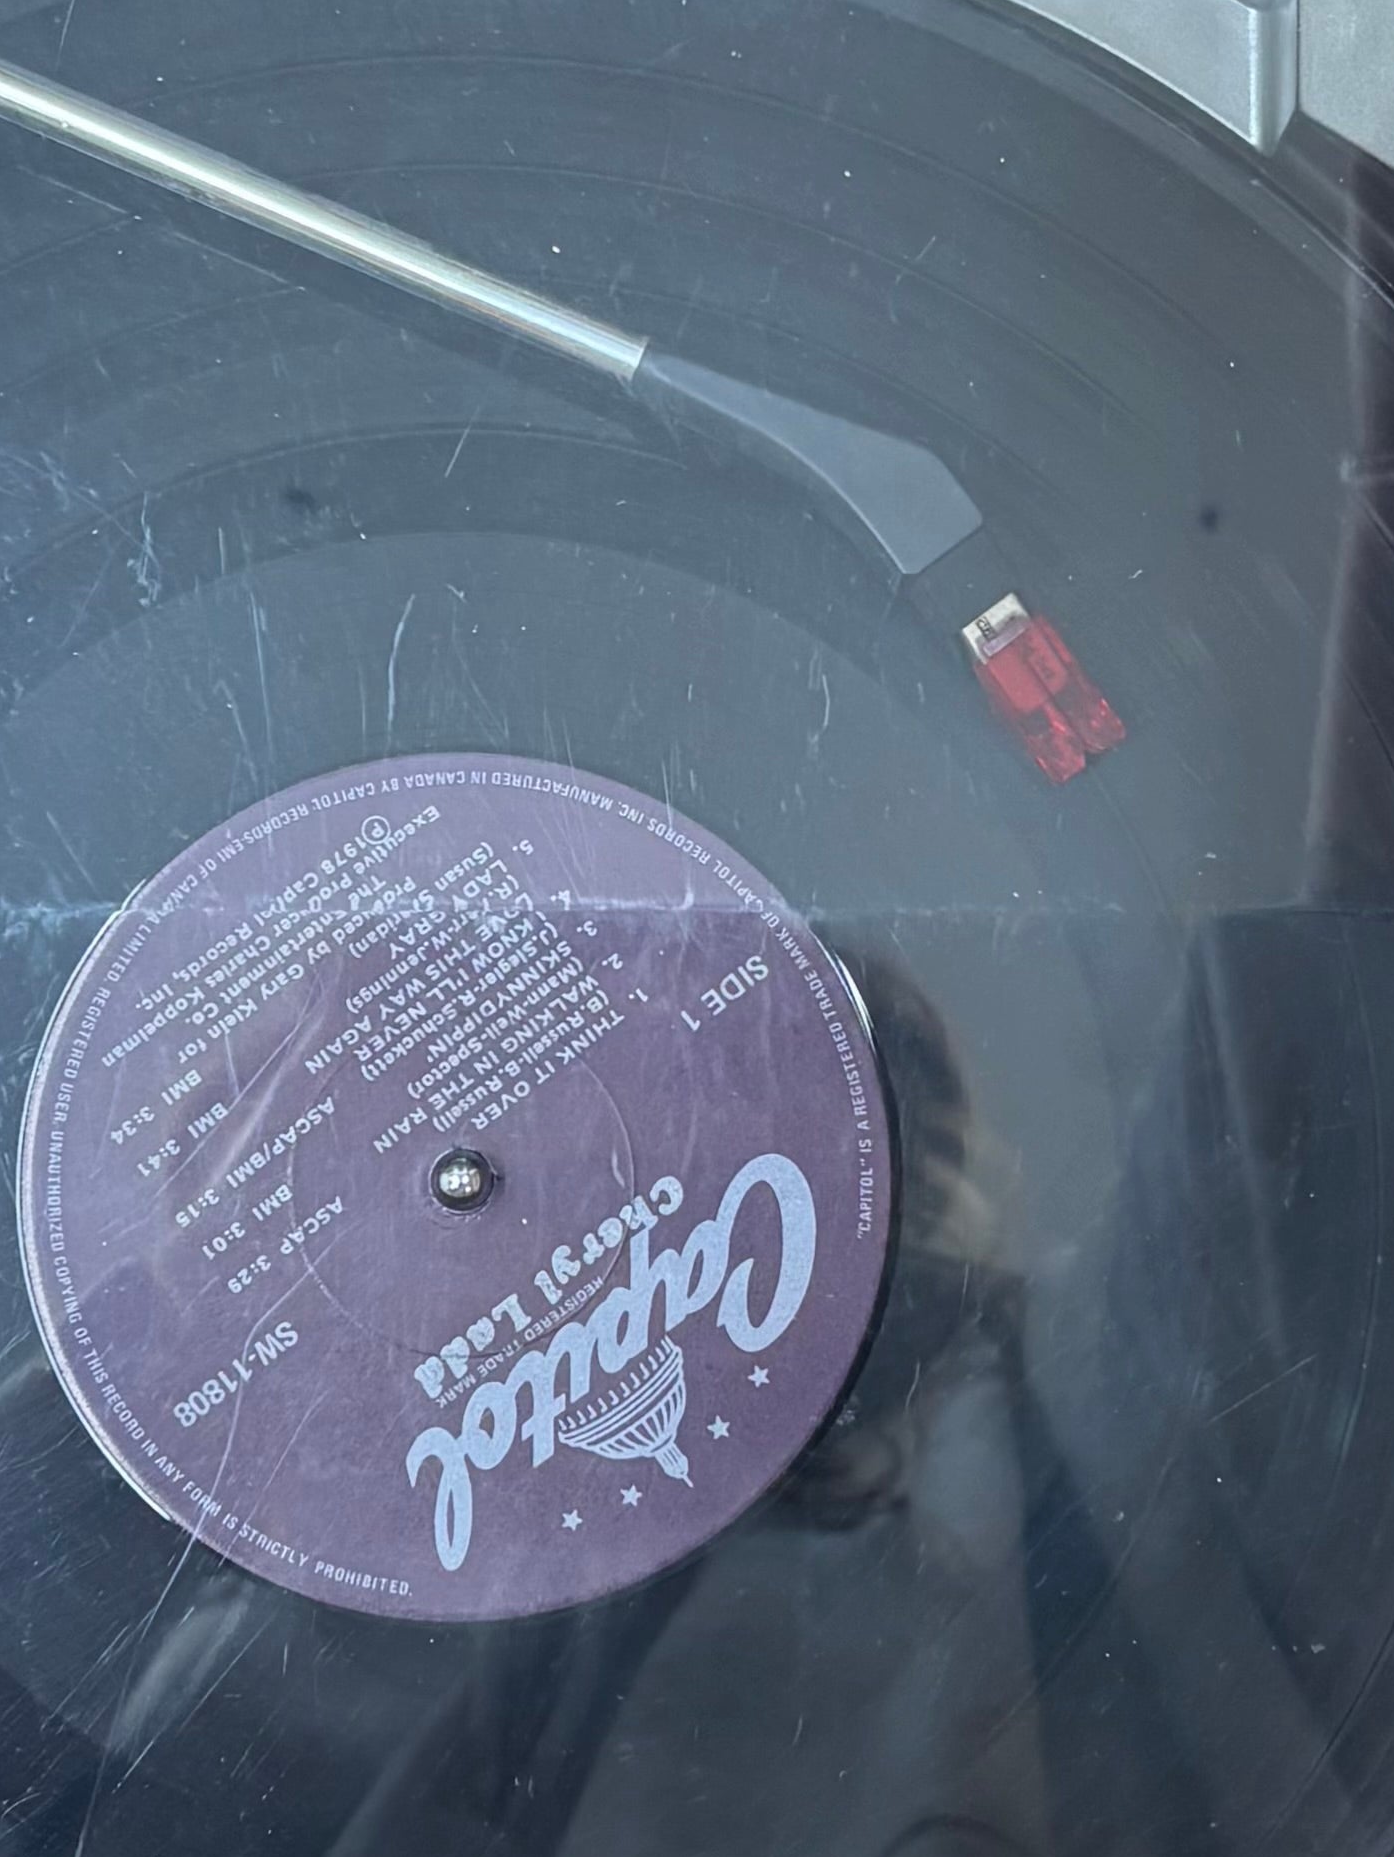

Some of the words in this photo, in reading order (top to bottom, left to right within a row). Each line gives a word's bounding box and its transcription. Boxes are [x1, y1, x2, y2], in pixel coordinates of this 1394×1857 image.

[310, 781, 375, 810] CAPITOL
[380, 776, 399, 793] BY
[402, 770, 466, 788] CANADA
[469, 769, 487, 785] IN
[490, 771, 613, 811] MANUFACTURED
[617, 800, 645, 824] INC.
[215, 803, 309, 862] RECORDS-EMI
[352, 804, 440, 874] Executive
[511, 838, 534, 855] 5.
[646, 817, 711, 864] RECORDS
[197, 857, 217, 879] OF
[433, 841, 494, 891] (Susan
[451, 858, 508, 912] LADY
[347, 874, 387, 911] The
[549, 888, 572, 911] 4.
[388, 907, 446, 960] GRAY
[474, 891, 534, 945] LOVE
[534, 910, 547, 921] I
[575, 919, 598, 937] 3.
[759, 910, 780, 928] OF
[103, 923, 152, 982] LIMITED.
[171, 921, 253, 982] Records,
[203, 934, 271, 988] Charles
[306, 939, 332, 965] by
[424, 938, 476, 981] THIS
[471, 917, 534, 973] KNOW
[600, 952, 623, 970] 2.
[774, 925, 810, 970] MARK
[134, 982, 174, 1010] Inc.
[259, 962, 304, 1001] Gary
[378, 977, 426, 1021] WAY
[424, 967, 470, 1001] I'LL
[426, 940, 571, 1062] SKINNYDIPPIN'
[627, 987, 649, 1002] 1.
[700, 954, 769, 1015] SIDE
[803, 969, 837, 1020] TRADE
[63, 986, 111, 1079] REGISTERED
[101, 985, 205, 1067] Koppelman
[184, 1001, 219, 1025] Co.
[206, 997, 258, 1039] Klein
[352, 1000, 427, 1061] NEVER
[499, 974, 599, 1053] WALKING
[679, 1009, 701, 1031] 1
[177, 1037, 207, 1064] for
[304, 1014, 372, 1074] AGAIN
[554, 1009, 625, 1065] THINK
[472, 1049, 500, 1075] IN
[533, 1059, 556, 1085] IT
[828, 1021, 867, 1116] REGISTERED
[51, 1081, 74, 1125] USER.
[160, 1068, 202, 1105] BMI
[427, 1072, 475, 1111] THE
[469, 1080, 530, 1130] OVER
[109, 1105, 155, 1145] 3:34
[186, 1101, 229, 1139] BMI
[372, 1106, 428, 1153] RAIN
[855, 1119, 870, 1130] A
[136, 1138, 180, 1177] 3:41
[225, 1096, 334, 1188] ASCAP/BMI
[857, 1137, 872, 1153] IS
[46, 1130, 65, 1252] UNAUTHORIZED
[174, 1187, 220, 1228] 3:15
[251, 1183, 293, 1221] BMI
[856, 1157, 874, 1239] "CAPITOL"
[201, 1221, 246, 1260] 3:01
[279, 1195, 343, 1255] ASCAP
[533, 1175, 683, 1304] Cheryl
[53, 1255, 82, 1324] COPYING
[226, 1254, 272, 1293] 3:29
[523, 1275, 604, 1341] REGISTERED
[72, 1326, 92, 1346] OF
[413, 1293, 531, 1398] Ladd
[82, 1347, 109, 1384] THIS
[173, 1321, 298, 1427] SW-11808
[405, 1154, 823, 1570] Capitol
[476, 1338, 521, 1378] TRADE
[434, 1373, 477, 1409] MARK
[100, 1383, 145, 1440] RECORD
[139, 1438, 159, 1457] IN
[153, 1455, 185, 1482] ANY
[181, 1480, 222, 1517] FORM
[221, 1512, 239, 1530] IS
[237, 1521, 309, 1567] STRICTLY
[313, 1560, 412, 1596] PROHIBITED.
